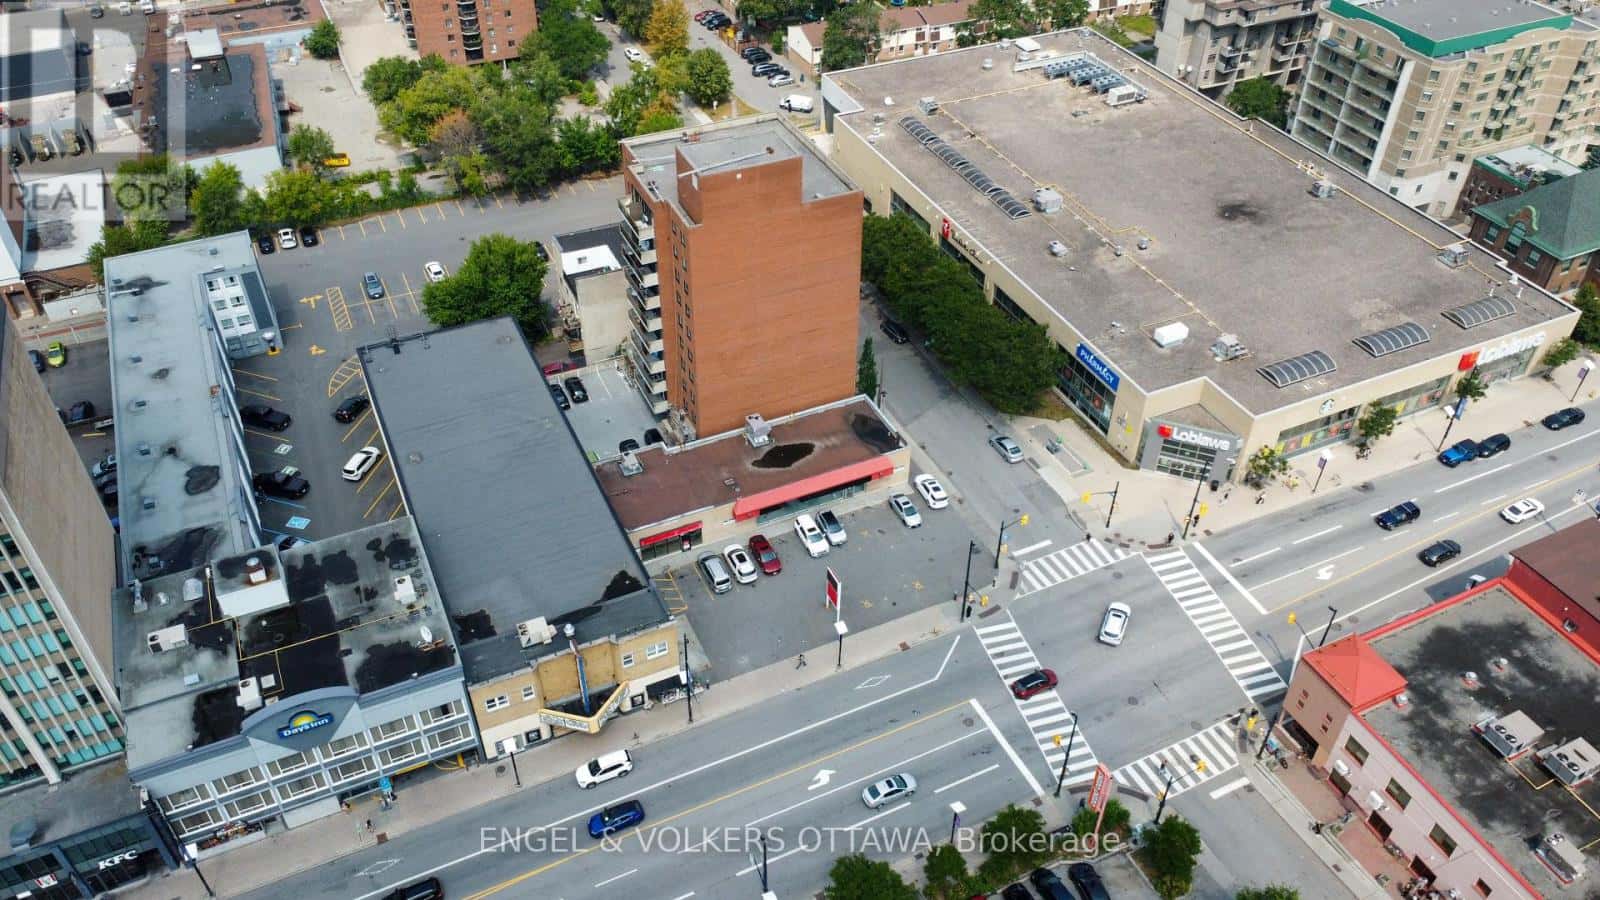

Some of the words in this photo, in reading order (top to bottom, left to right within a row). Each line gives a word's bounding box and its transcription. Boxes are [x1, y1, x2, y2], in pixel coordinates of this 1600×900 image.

[1172, 426, 1231, 451] Loblaws
[283, 724, 310, 737] Days
[98, 849, 138, 870] KFC
